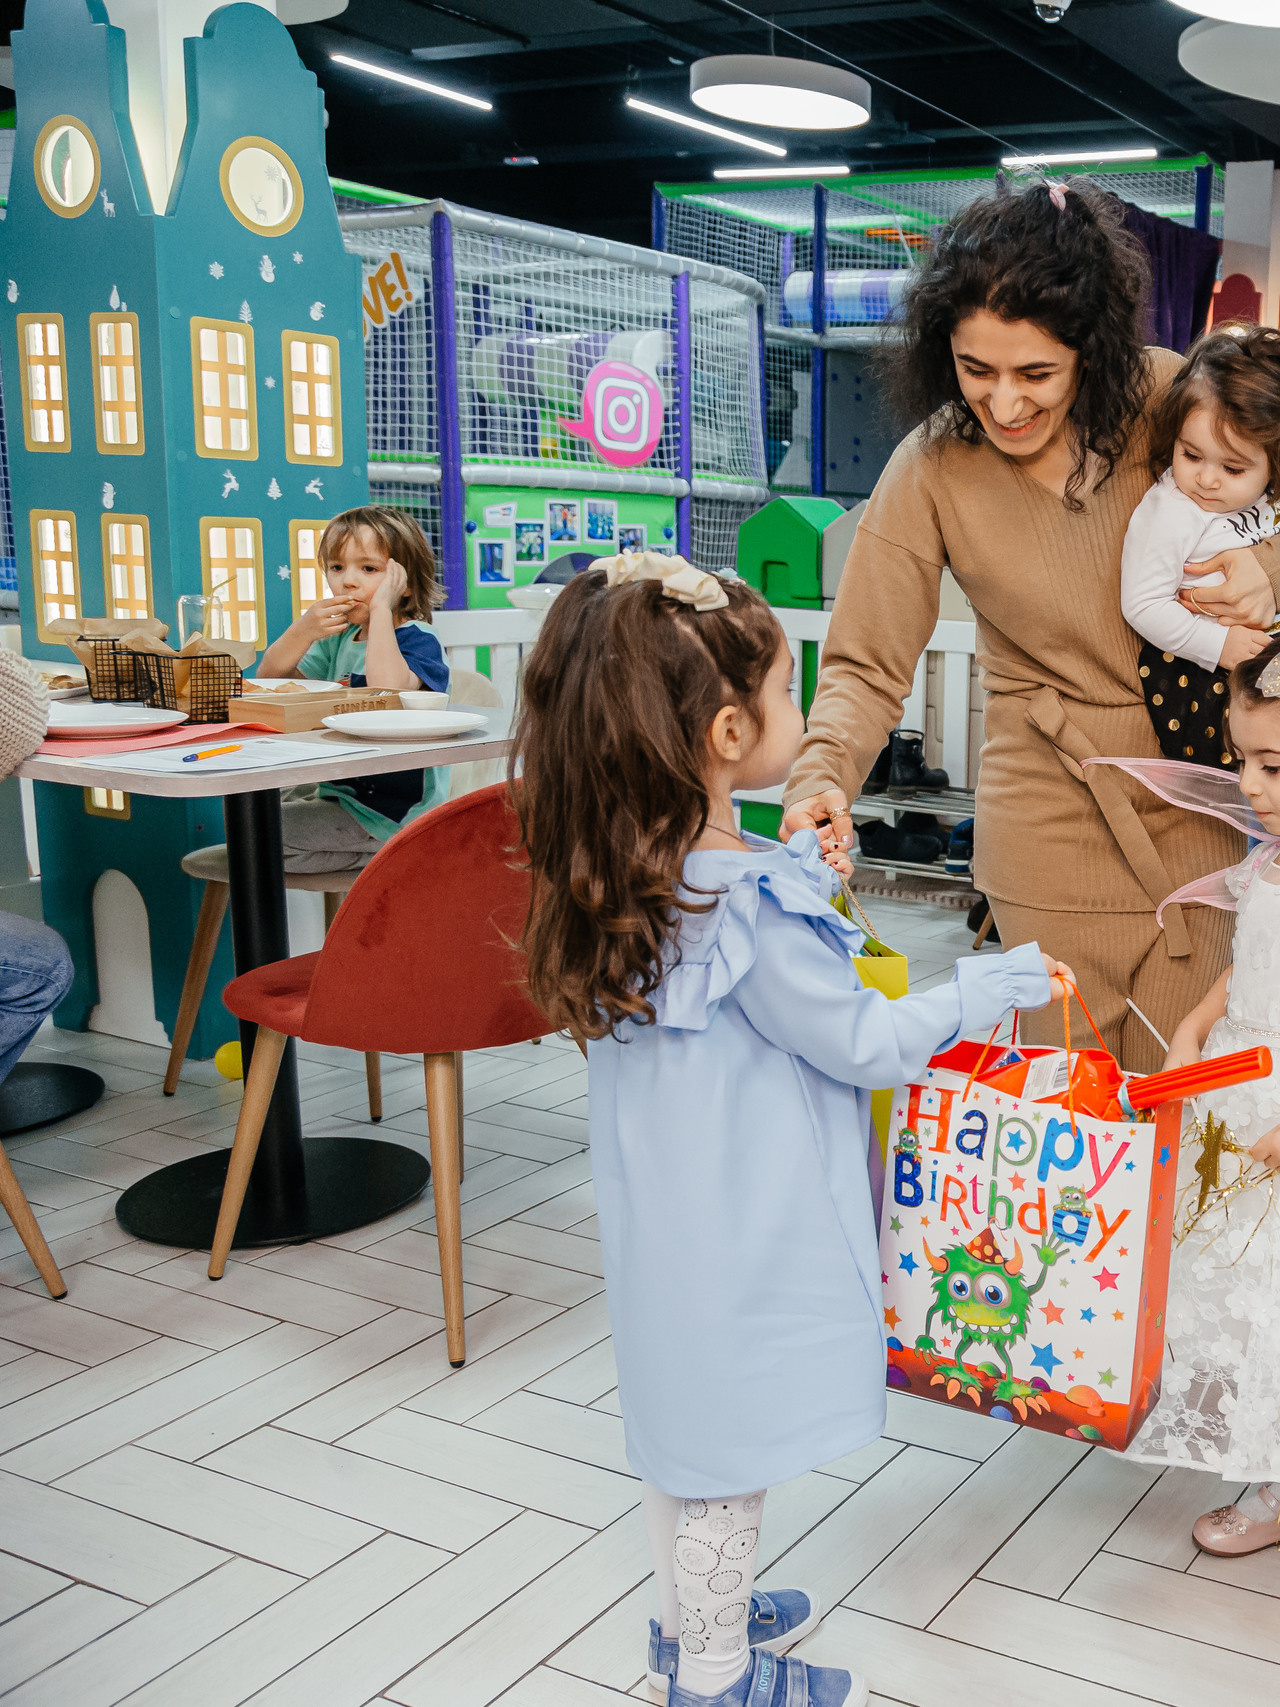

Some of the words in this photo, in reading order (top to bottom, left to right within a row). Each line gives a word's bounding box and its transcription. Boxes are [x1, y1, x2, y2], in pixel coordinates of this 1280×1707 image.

[362, 252, 413, 338] VE!
[1227, 505, 1261, 538] MY
[904, 1083, 1132, 1200] Happy
